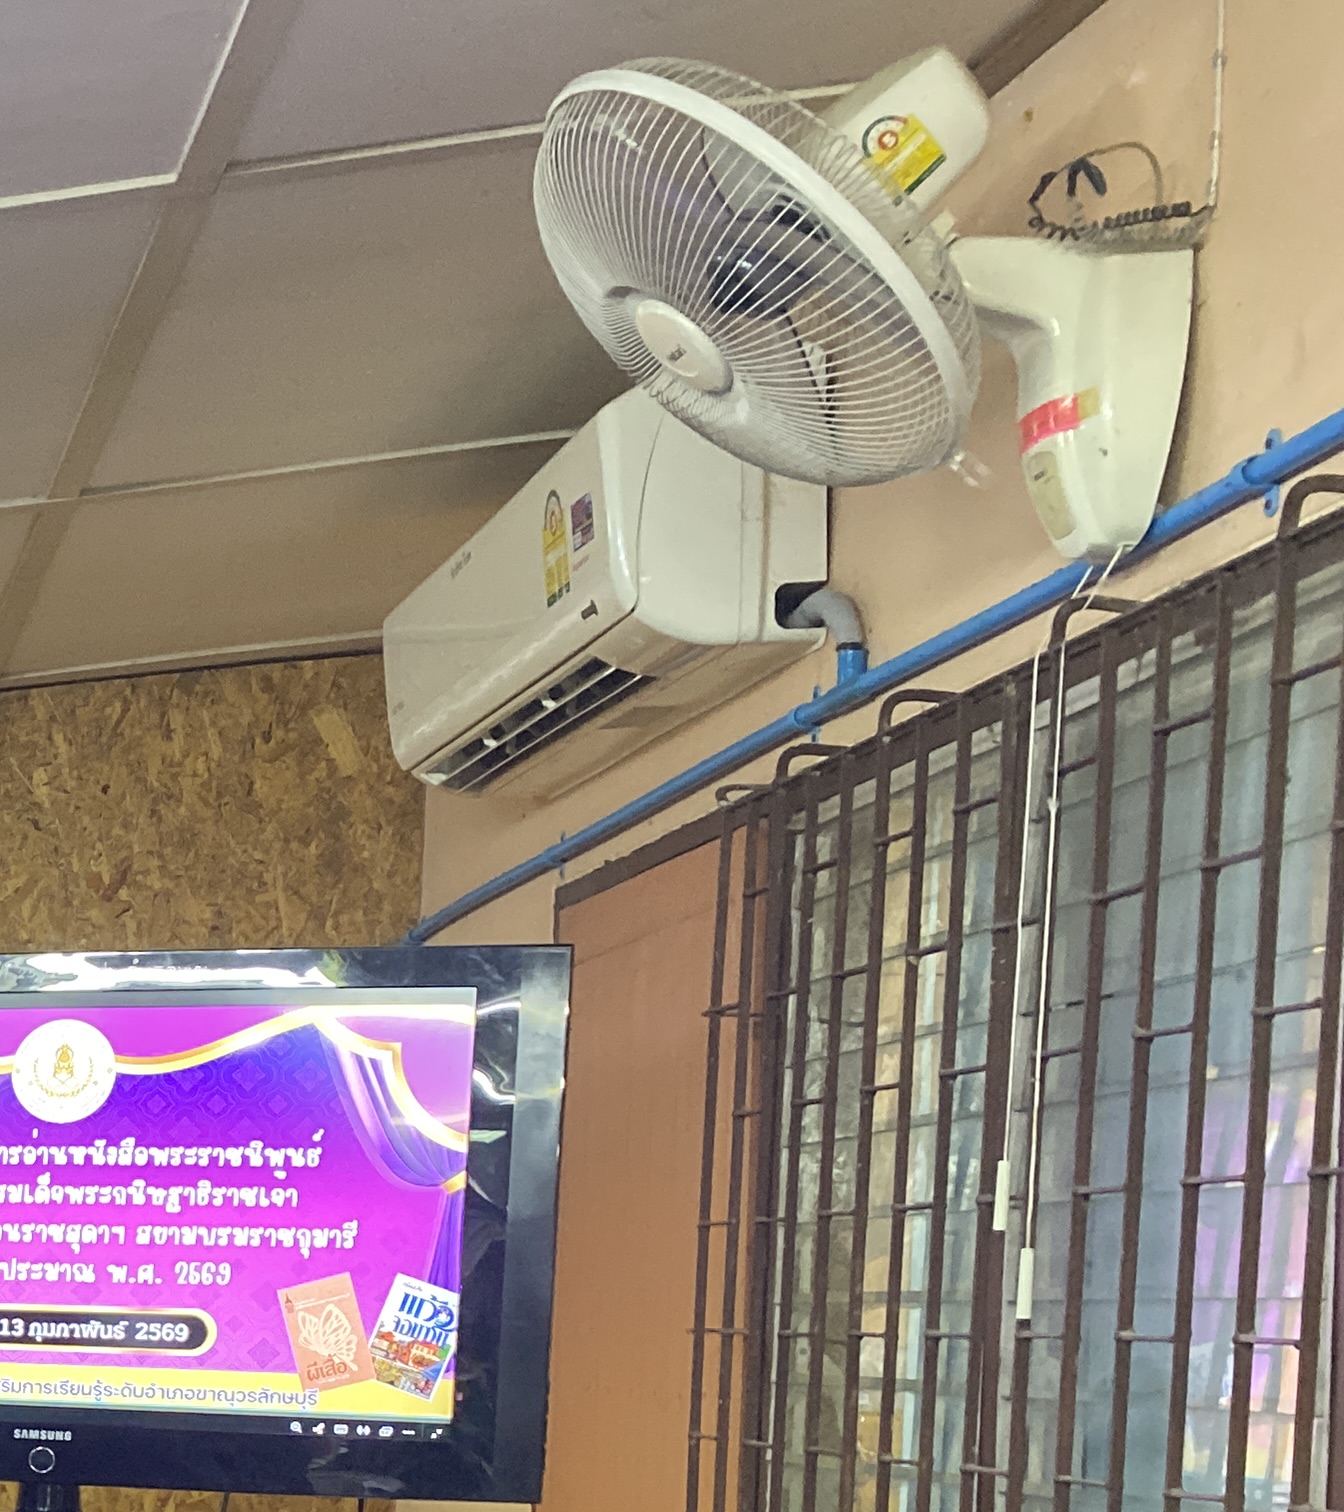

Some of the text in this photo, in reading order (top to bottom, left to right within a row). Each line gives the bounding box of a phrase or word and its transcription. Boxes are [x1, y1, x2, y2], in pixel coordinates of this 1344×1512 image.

[107, 1263, 163, 1285] พ.ศ.
[175, 1261, 232, 1286] 2569
[27, 1320, 130, 1343] กุมภาพันธ์
[134, 1322, 190, 1343] 2569
[13, 1428, 73, 1442] SAMSUNG
